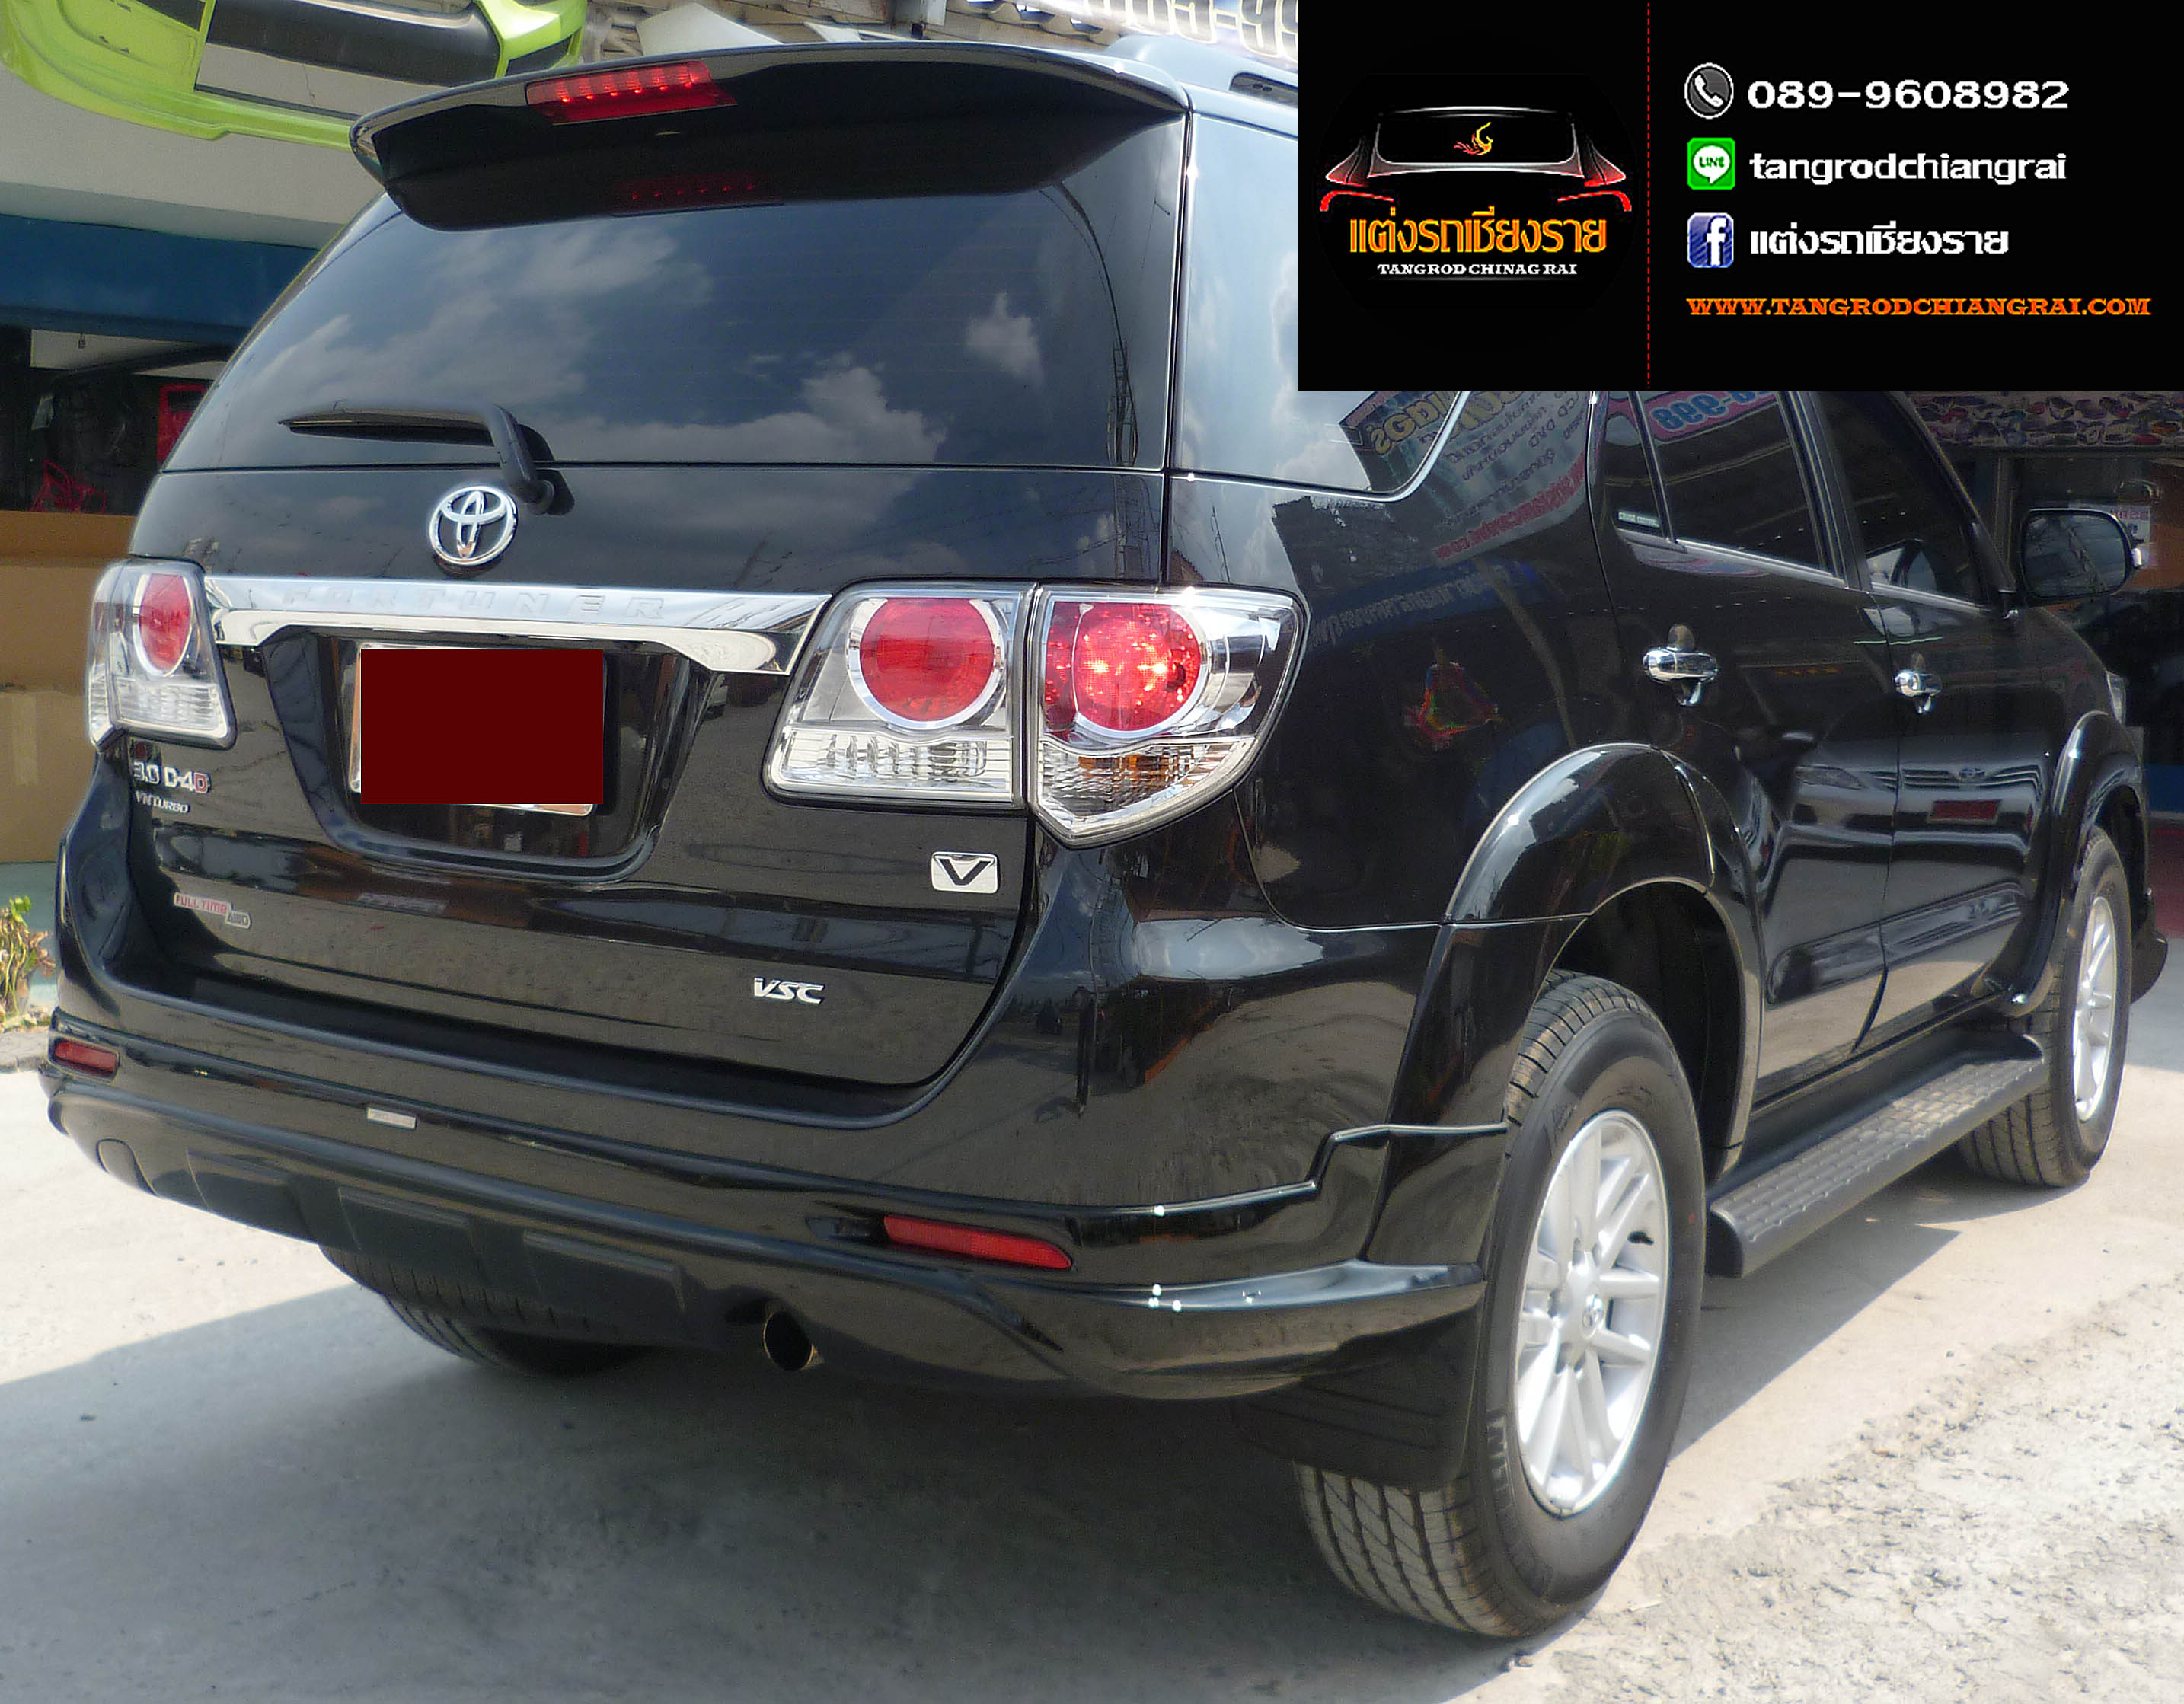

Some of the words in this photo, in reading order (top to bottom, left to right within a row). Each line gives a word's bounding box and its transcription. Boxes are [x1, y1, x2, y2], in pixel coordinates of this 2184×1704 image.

[282, 584, 665, 620] FORTUNER
[164, 766, 209, 793] D-4D
[934, 856, 995, 886] V
[753, 977, 824, 1005] VSC
